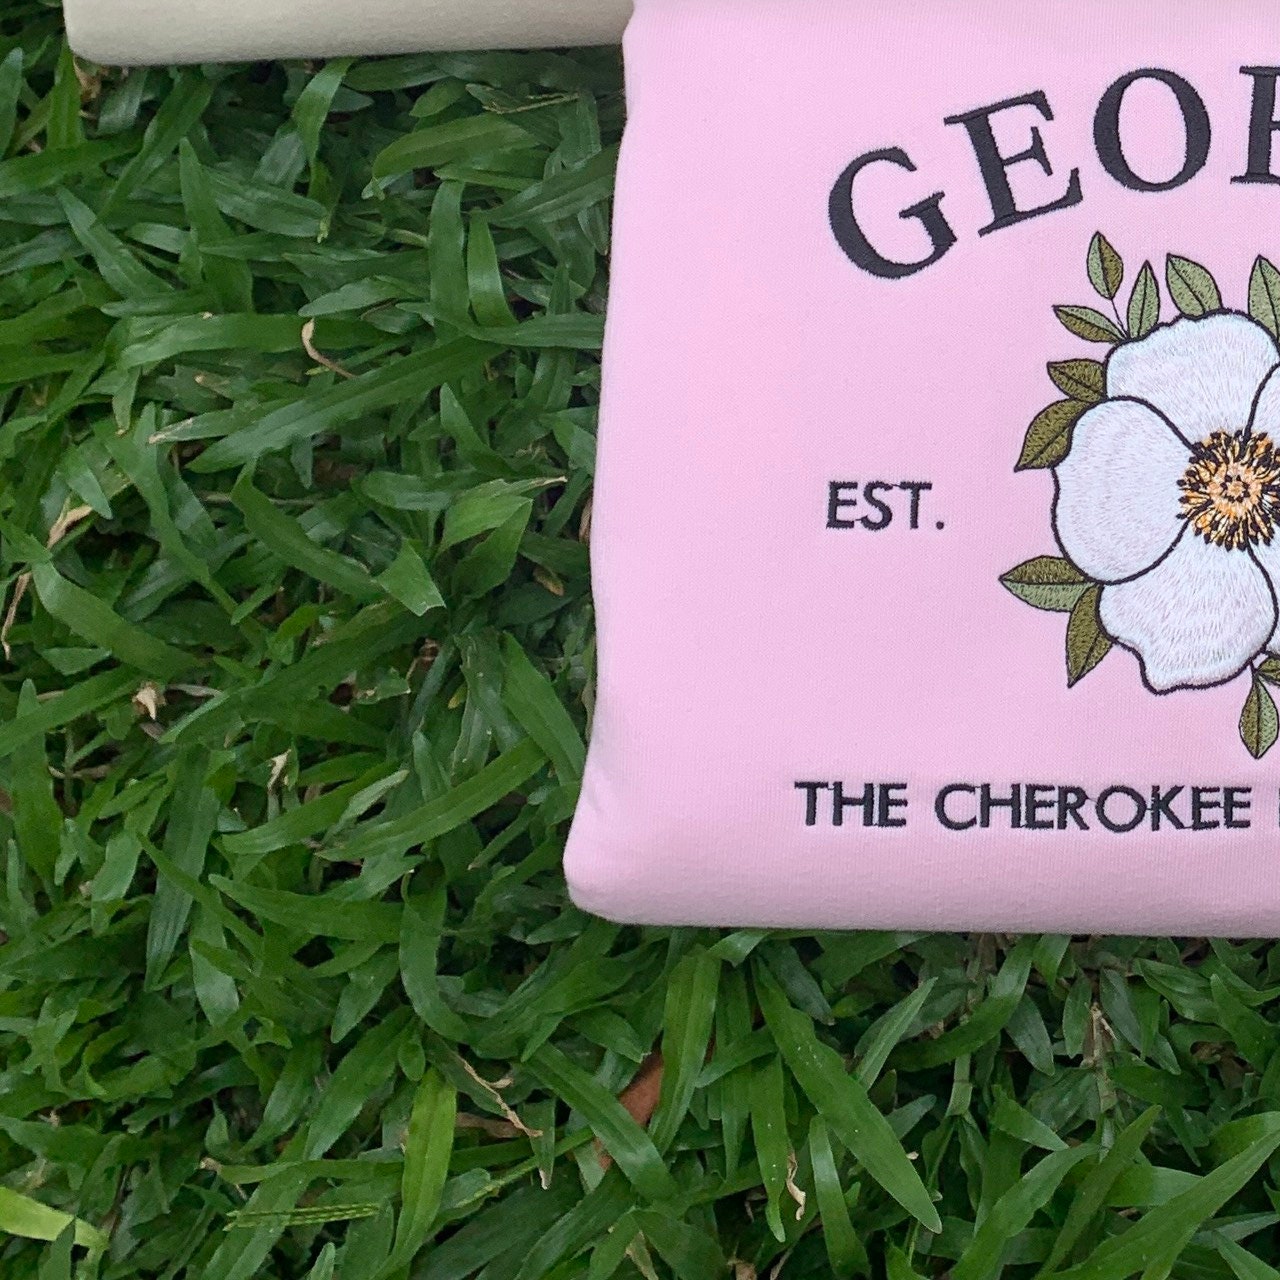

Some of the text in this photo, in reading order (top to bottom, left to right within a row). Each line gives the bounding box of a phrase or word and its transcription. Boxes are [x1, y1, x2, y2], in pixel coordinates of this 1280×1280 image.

[826, 481, 944, 530] EST.
[795, 782, 908, 827] THE
[935, 783, 1251, 832] CHEROKEE
